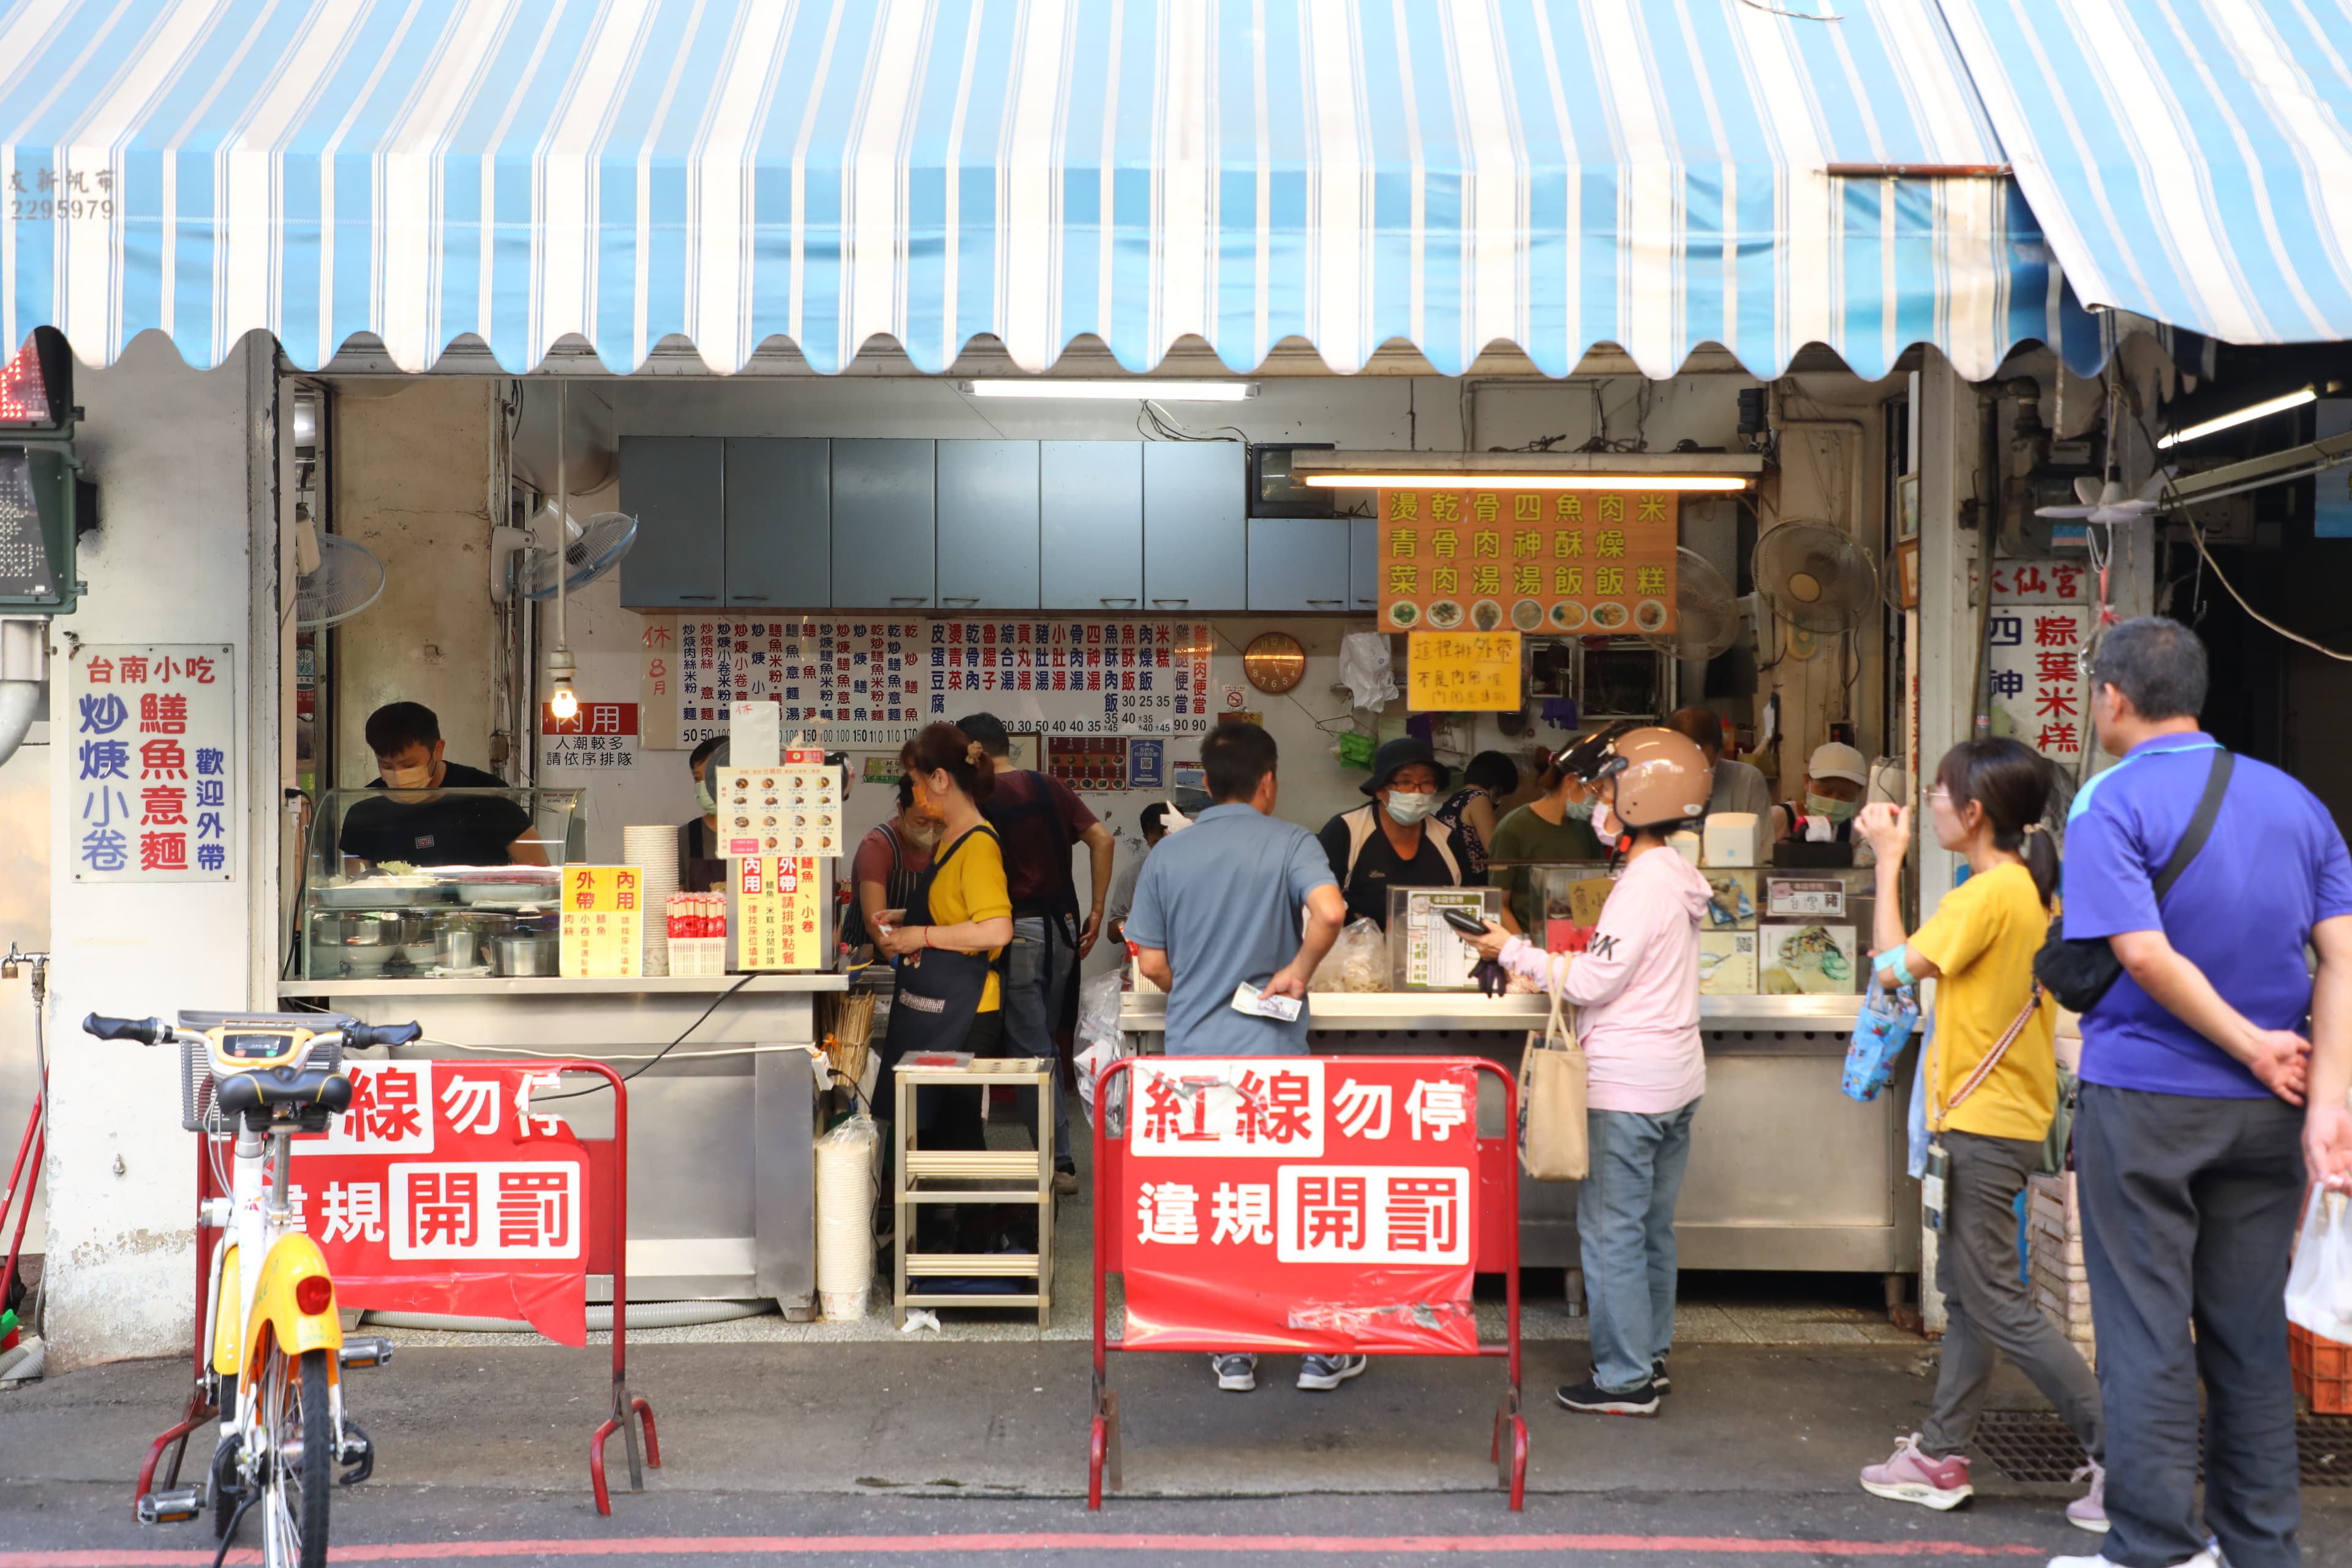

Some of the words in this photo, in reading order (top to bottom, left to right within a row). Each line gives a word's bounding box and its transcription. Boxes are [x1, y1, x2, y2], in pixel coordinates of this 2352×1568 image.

[11, 199, 115, 220] 2295979
[1389, 492, 1419, 595] 燙青菜
[1431, 492, 1460, 595] 乾骨肉
[1472, 492, 1501, 595] 骨肉湯
[1511, 494, 1542, 596] 四神湯
[1554, 492, 1583, 596] 魚酥飯
[1596, 493, 1626, 596] 肉燥飯
[1637, 494, 1667, 596] 米糕
[948, 624, 962, 690] 燙青菜
[966, 624, 979, 690] 乾骨肉
[1001, 624, 1014, 690] 綜合湯
[1017, 624, 1031, 691] 貢丸湯
[1035, 624, 1049, 691] 豬肚湯
[1052, 624, 1066, 691] 小肚湯
[1070, 624, 1084, 691] 骨肉湯
[1087, 625, 1101, 691] 四神湯
[1121, 625, 1135, 691] 魚酥飯
[1139, 625, 1153, 691] 肉燥飯
[1156, 625, 1170, 668] 米糕
[87, 655, 215, 684] 台南小吃
[931, 624, 944, 714] 皮蛋豆腐
[1104, 625, 1118, 712] 魚酥肉飯
[2035, 615, 2078, 753] 粽葉米糕
[1104, 713, 1118, 724] 35
[1121, 696, 1135, 707] 30
[1121, 713, 1135, 724] 40
[1139, 696, 1153, 707] 25
[1156, 696, 1170, 707] 35
[556, 736, 623, 750] 人潮較多
[684, 729, 697, 742] 50
[803, 729, 816, 742] 150
[837, 729, 850, 742] 100
[853, 729, 867, 742] 150
[870, 729, 883, 743] 110
[888, 729, 900, 742] 110
[1018, 721, 1031, 732] 30
[1035, 721, 1049, 732] 50
[1052, 721, 1066, 732] 40
[1069, 721, 1083, 732] 40
[1087, 721, 1101, 732] 35
[1174, 720, 1188, 730] 90
[1192, 720, 1206, 731] 90
[546, 752, 632, 766] 請依序排隊
[79, 693, 129, 872] 炒焿小卷
[139, 693, 188, 872] 鱔魚意麵
[195, 748, 225, 872] 歡迎外帶
[576, 871, 595, 910] 外帶
[616, 871, 635, 910] 內用
[744, 858, 761, 892] 內用
[778, 858, 796, 892] 外帶
[782, 896, 795, 964] 請排隊點餐
[1144, 1069, 1467, 1145] 紅線勿停
[1137, 1176, 1458, 1252] 違規開罰
